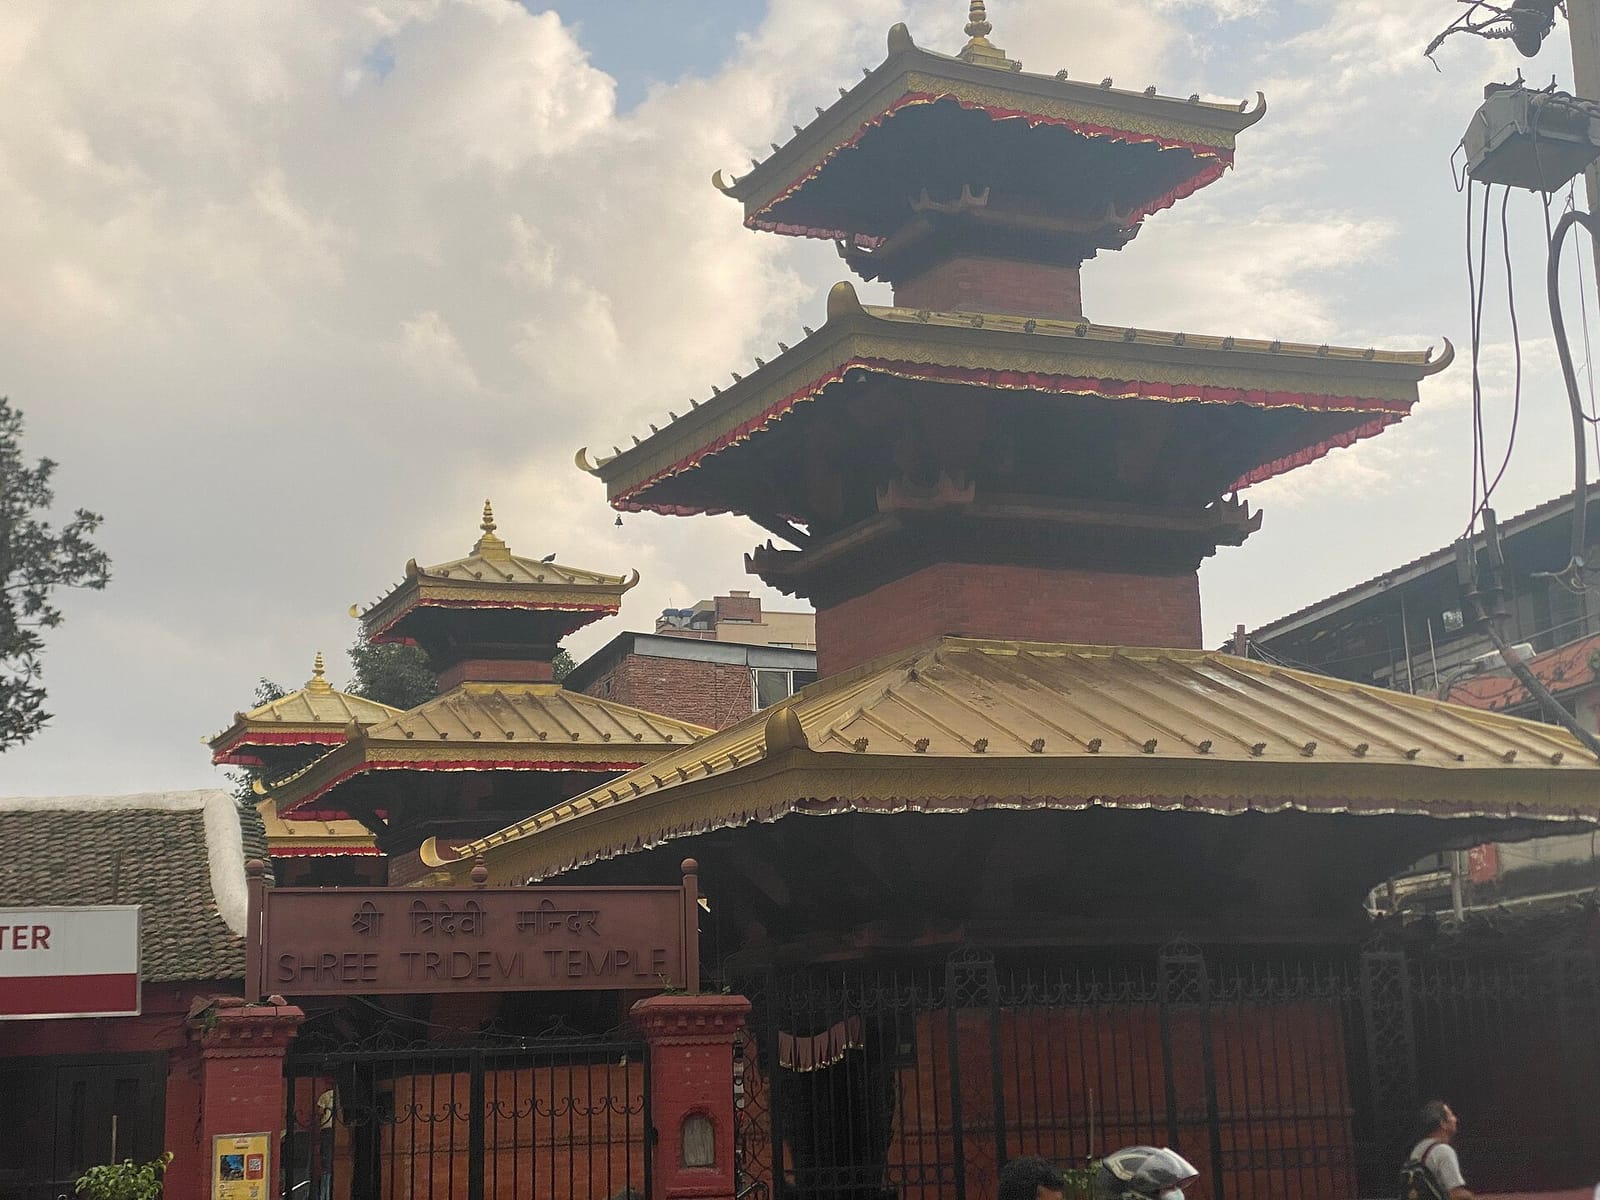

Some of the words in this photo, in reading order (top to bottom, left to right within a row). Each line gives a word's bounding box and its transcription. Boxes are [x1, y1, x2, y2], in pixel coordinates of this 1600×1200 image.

[351, 900, 384, 937] श्री
[408, 898, 487, 937] त्रिदेवी
[516, 897, 600, 936] मन्दिर
[277, 952, 378, 982] SHREE
[400, 950, 524, 980] TRIDEVI
[543, 949, 666, 978] TEMPLE
